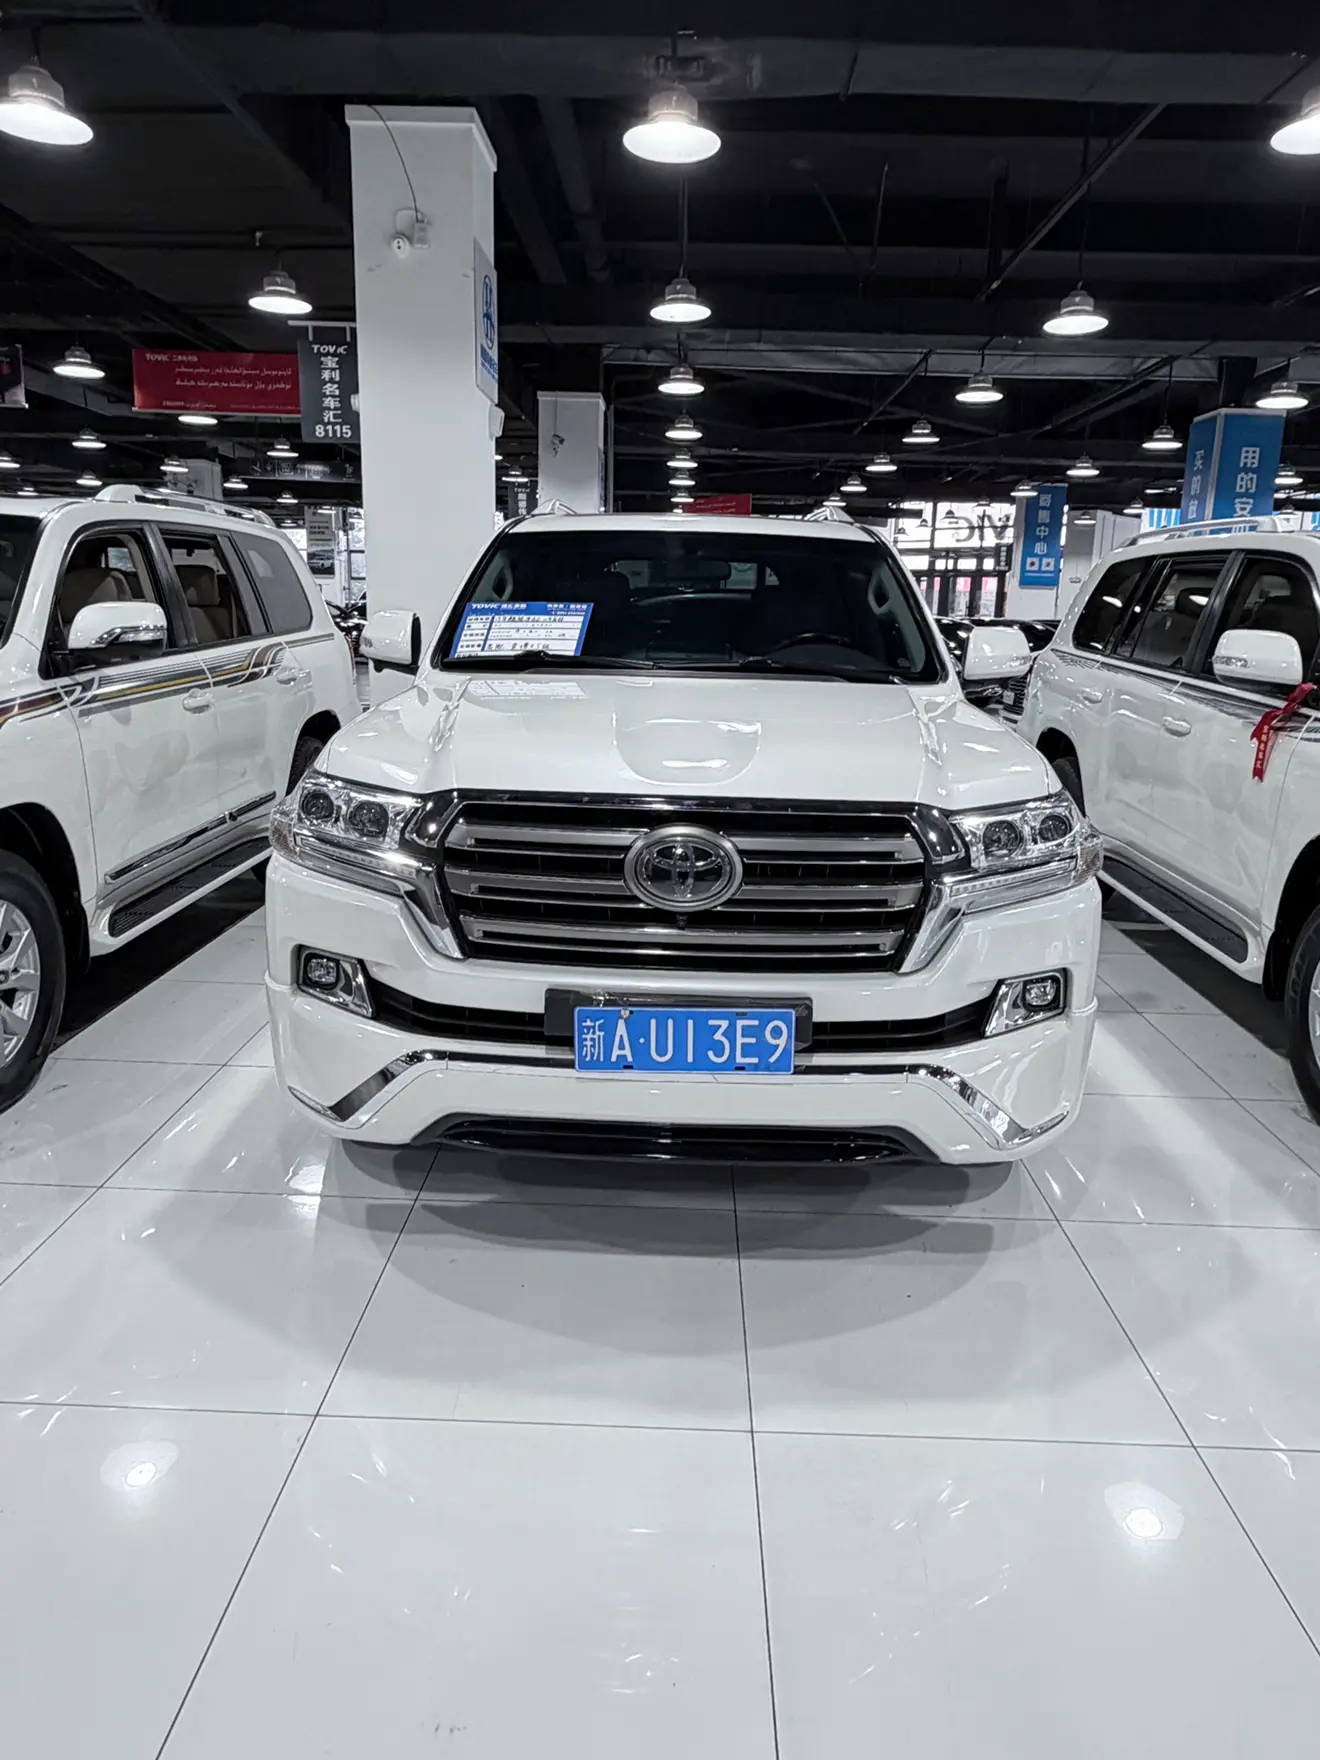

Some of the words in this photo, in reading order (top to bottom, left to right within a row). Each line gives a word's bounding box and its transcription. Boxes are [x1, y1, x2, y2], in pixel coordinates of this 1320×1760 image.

[320, 356, 342, 423] 宝利名车汇
[315, 424, 352, 438] 8115
[1231, 446, 1261, 534] 用的安
[582, 1018, 789, 1065] 新A·U13E9
